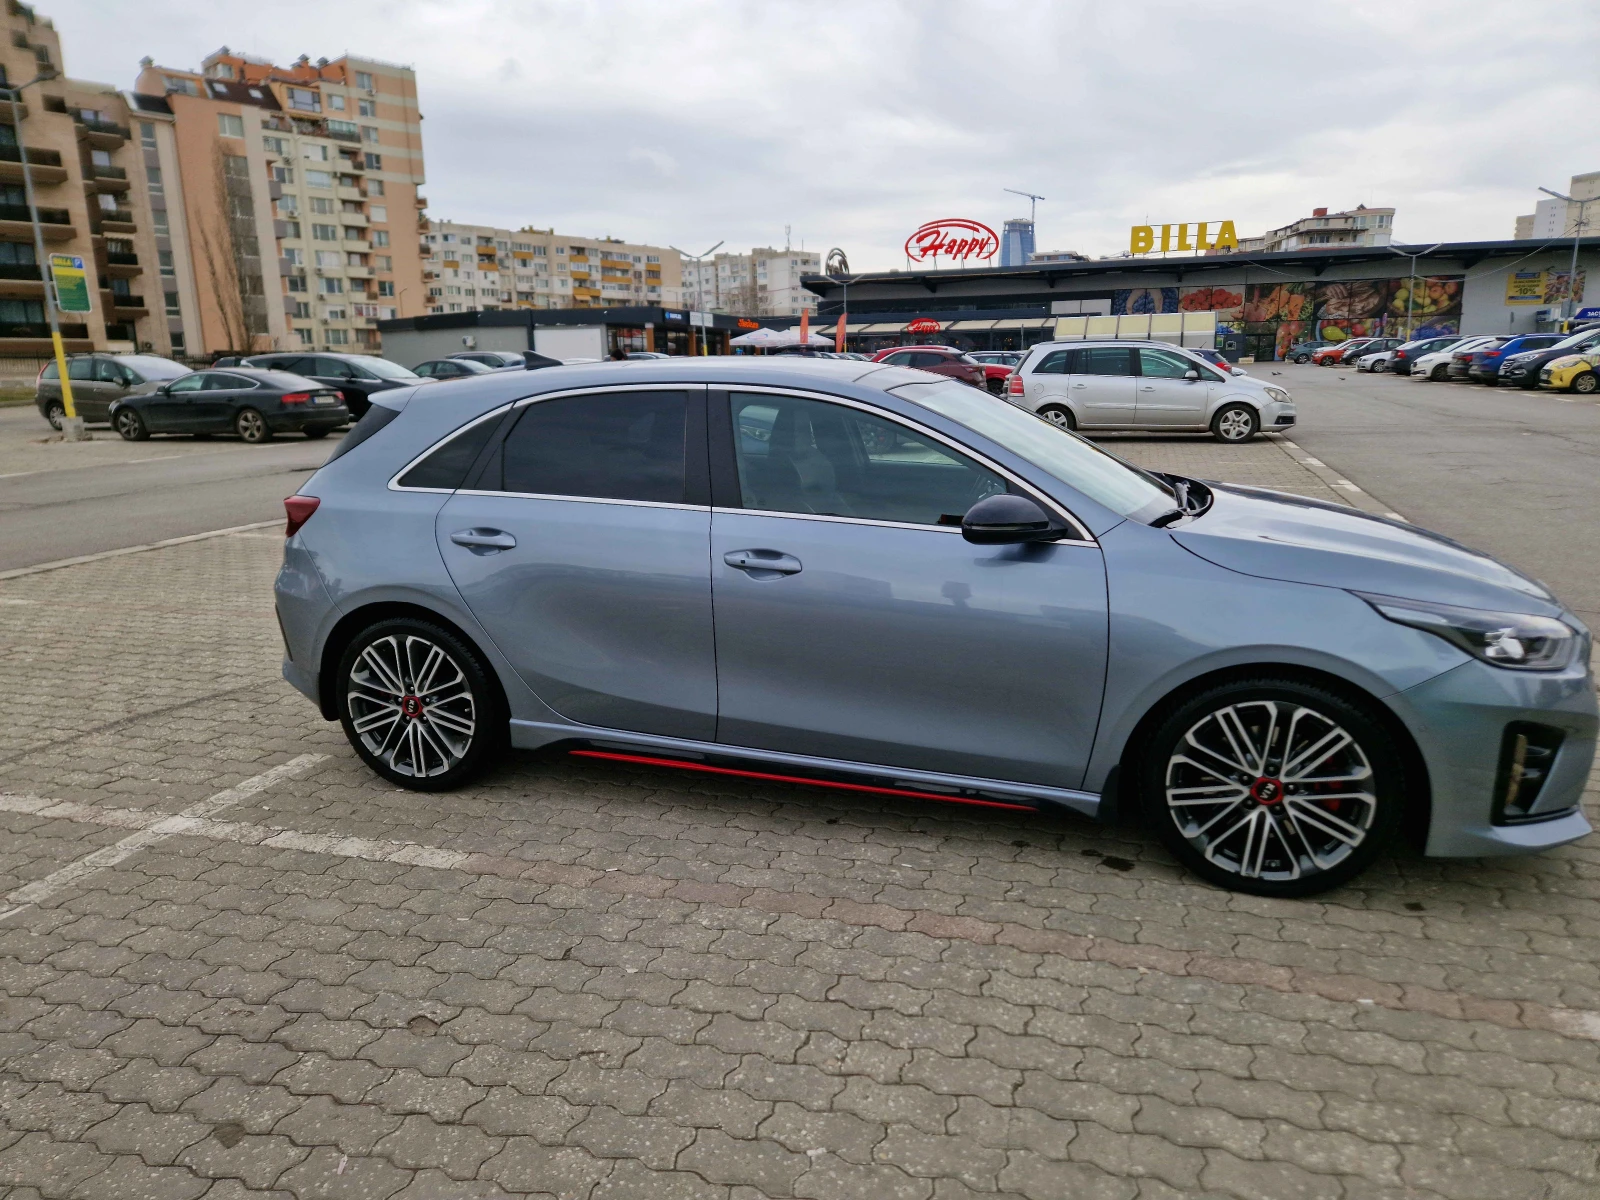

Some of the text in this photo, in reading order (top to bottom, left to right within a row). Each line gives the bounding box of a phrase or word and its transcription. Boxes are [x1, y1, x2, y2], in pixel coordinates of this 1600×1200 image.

[916, 229, 991, 260] Happy
[1130, 220, 1239, 254] BILLA
[1260, 783, 1276, 799] KIA
